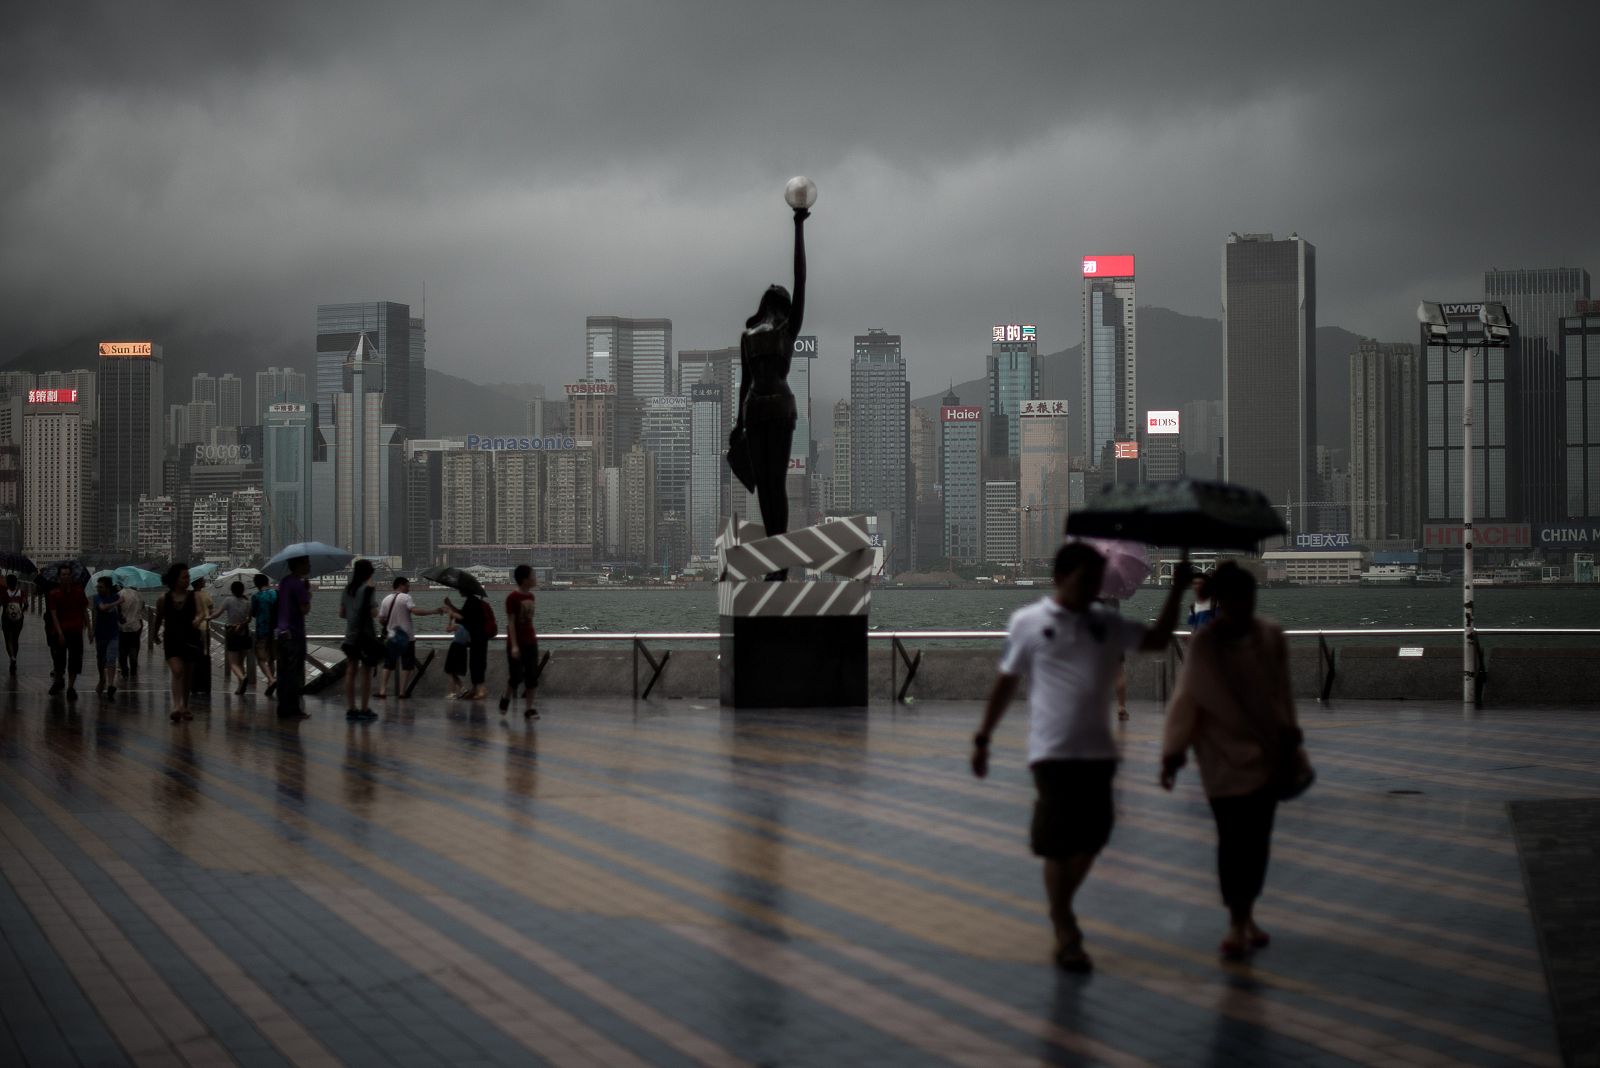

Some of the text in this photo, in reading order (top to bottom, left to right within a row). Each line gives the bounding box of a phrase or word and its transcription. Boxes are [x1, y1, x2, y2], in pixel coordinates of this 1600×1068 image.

[1443, 304, 1483, 314] LYMP
[111, 344, 151, 354] Sun Life
[793, 340, 815, 352] ON
[564, 384, 616, 393] TOSHIBA
[652, 397, 686, 405] MIDTOWN
[947, 409, 980, 419] Haier
[1158, 419, 1177, 427] DBS
[467, 433, 575, 451] Panasonic
[194, 445, 237, 460] SOGO
[788, 459, 805, 469] CL
[1297, 533, 1350, 547] 中国太平
[1541, 529, 1588, 542] CHINA
